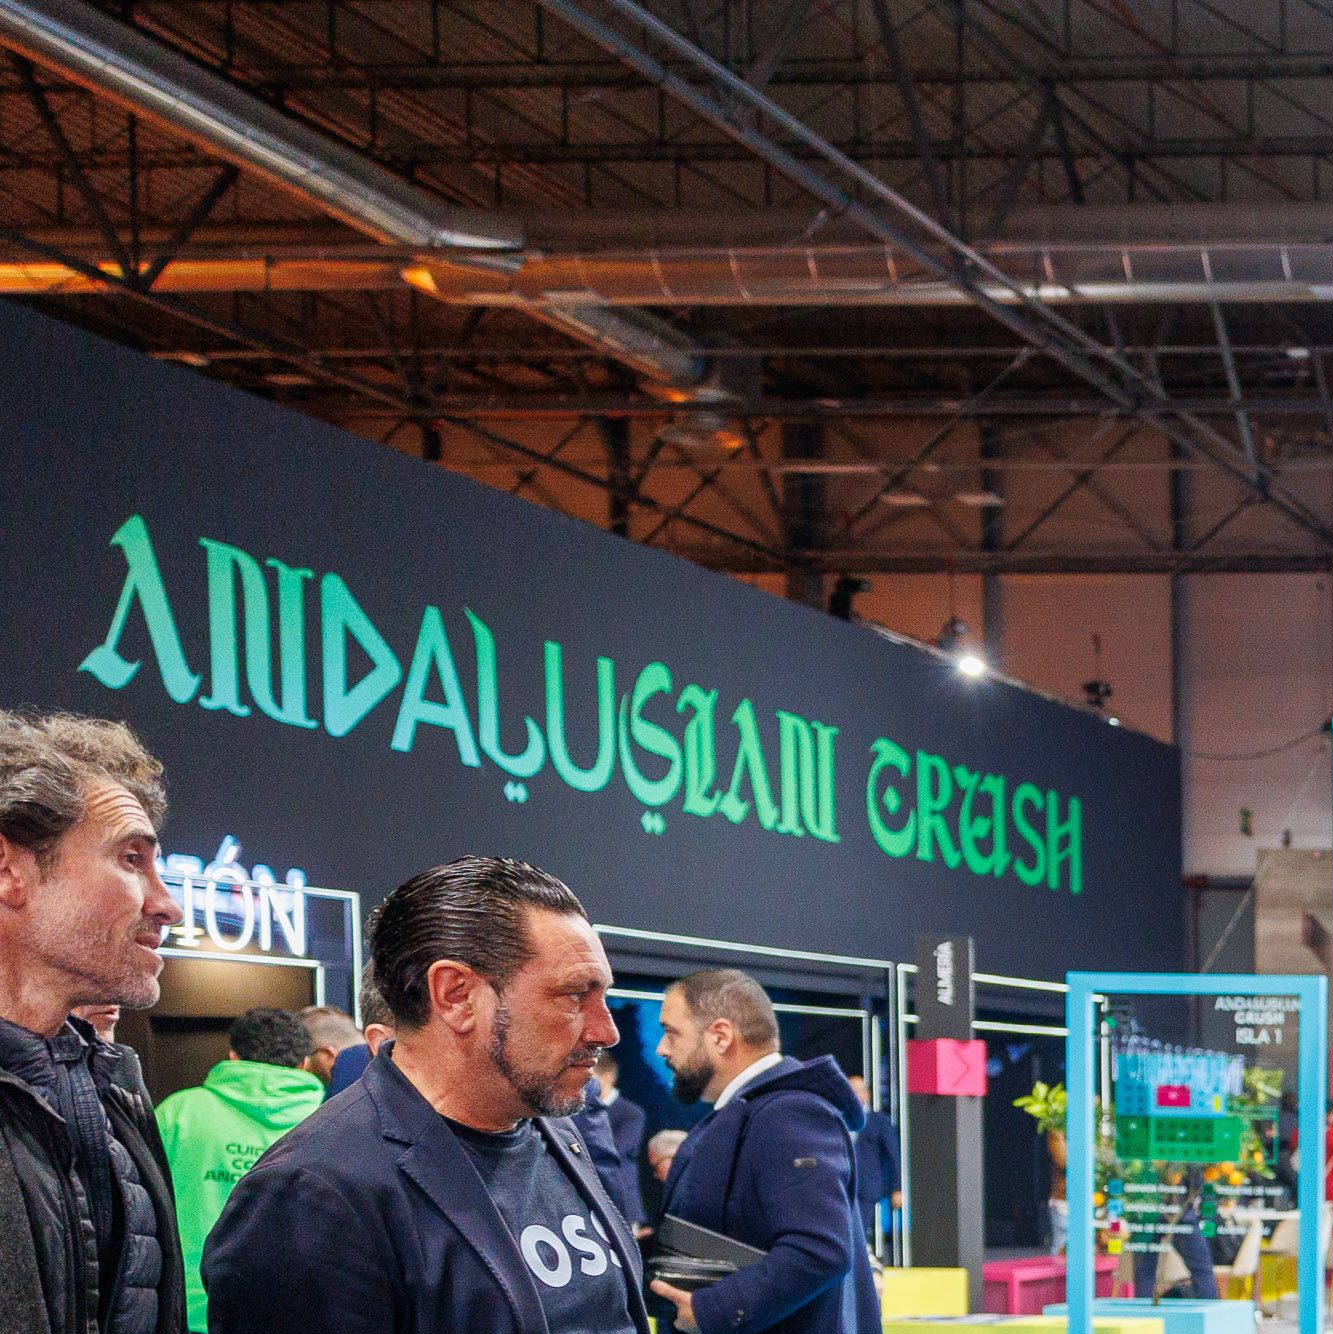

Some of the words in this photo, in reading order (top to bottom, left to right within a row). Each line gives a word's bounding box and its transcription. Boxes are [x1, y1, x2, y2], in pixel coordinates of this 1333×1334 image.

[78, 513, 841, 843] ANDALUSIAN
[866, 736, 1083, 894] CRUSH
[1273, 1027, 1283, 1045] 1
